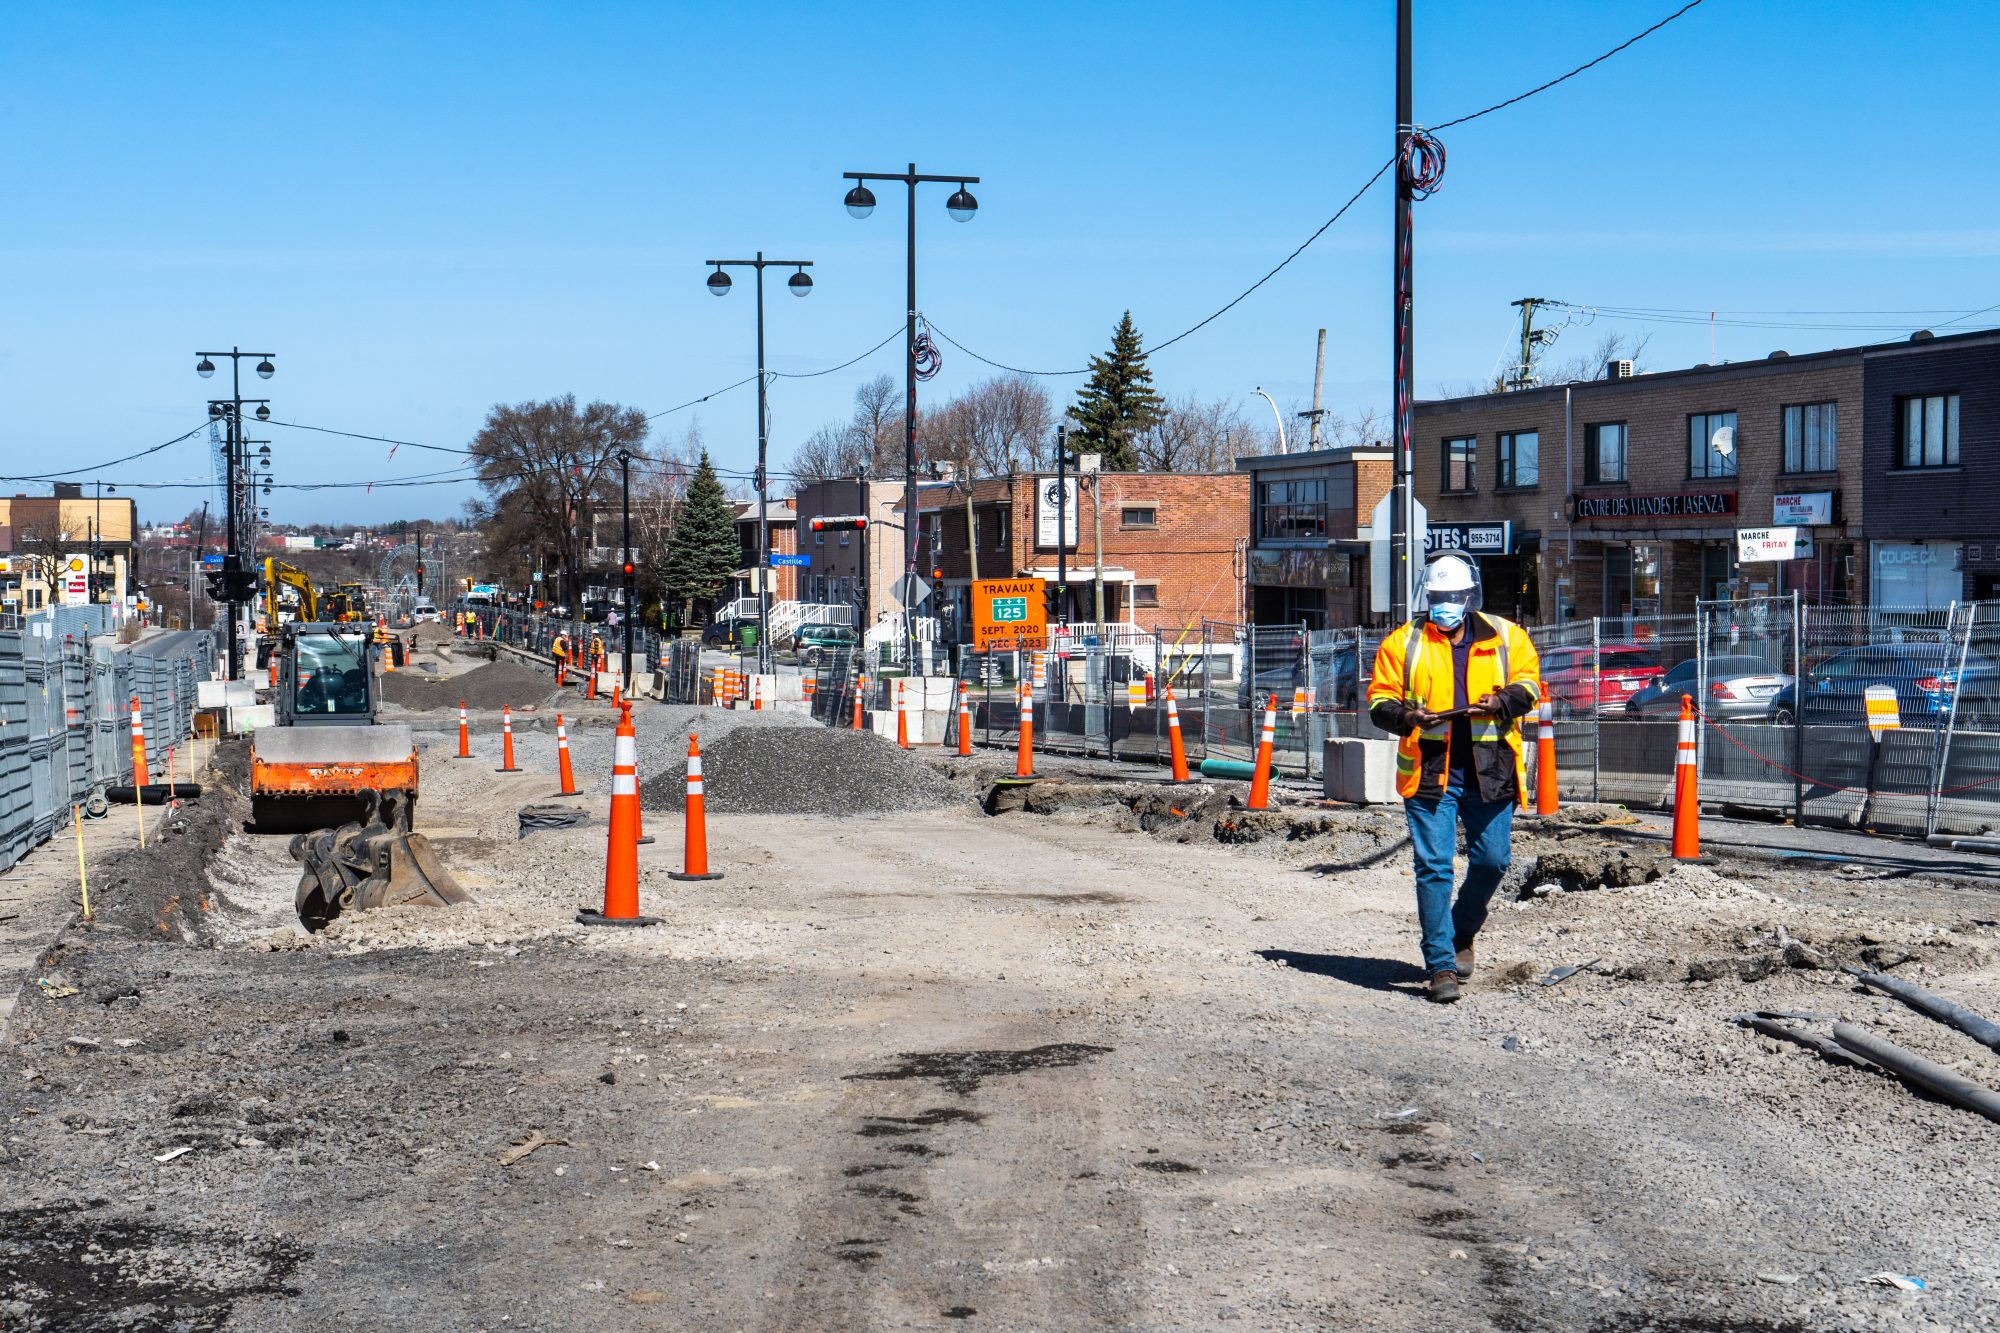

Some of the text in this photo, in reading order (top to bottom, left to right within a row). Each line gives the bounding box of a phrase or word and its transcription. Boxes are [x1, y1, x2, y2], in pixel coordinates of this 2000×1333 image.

[1578, 494, 1725, 517] CENTRE DES VIANDES F. IASENZA
[1471, 533, 1501, 544] 955-3714
[1762, 541, 1788, 549] FRITAY
[1879, 550, 1918, 564] COUPE
[983, 583, 1035, 594] TRAVAUX
[998, 607, 1022, 619] 125
[981, 625, 1039, 635] SEPT. 2020
[1015, 639, 1041, 648] 2023
